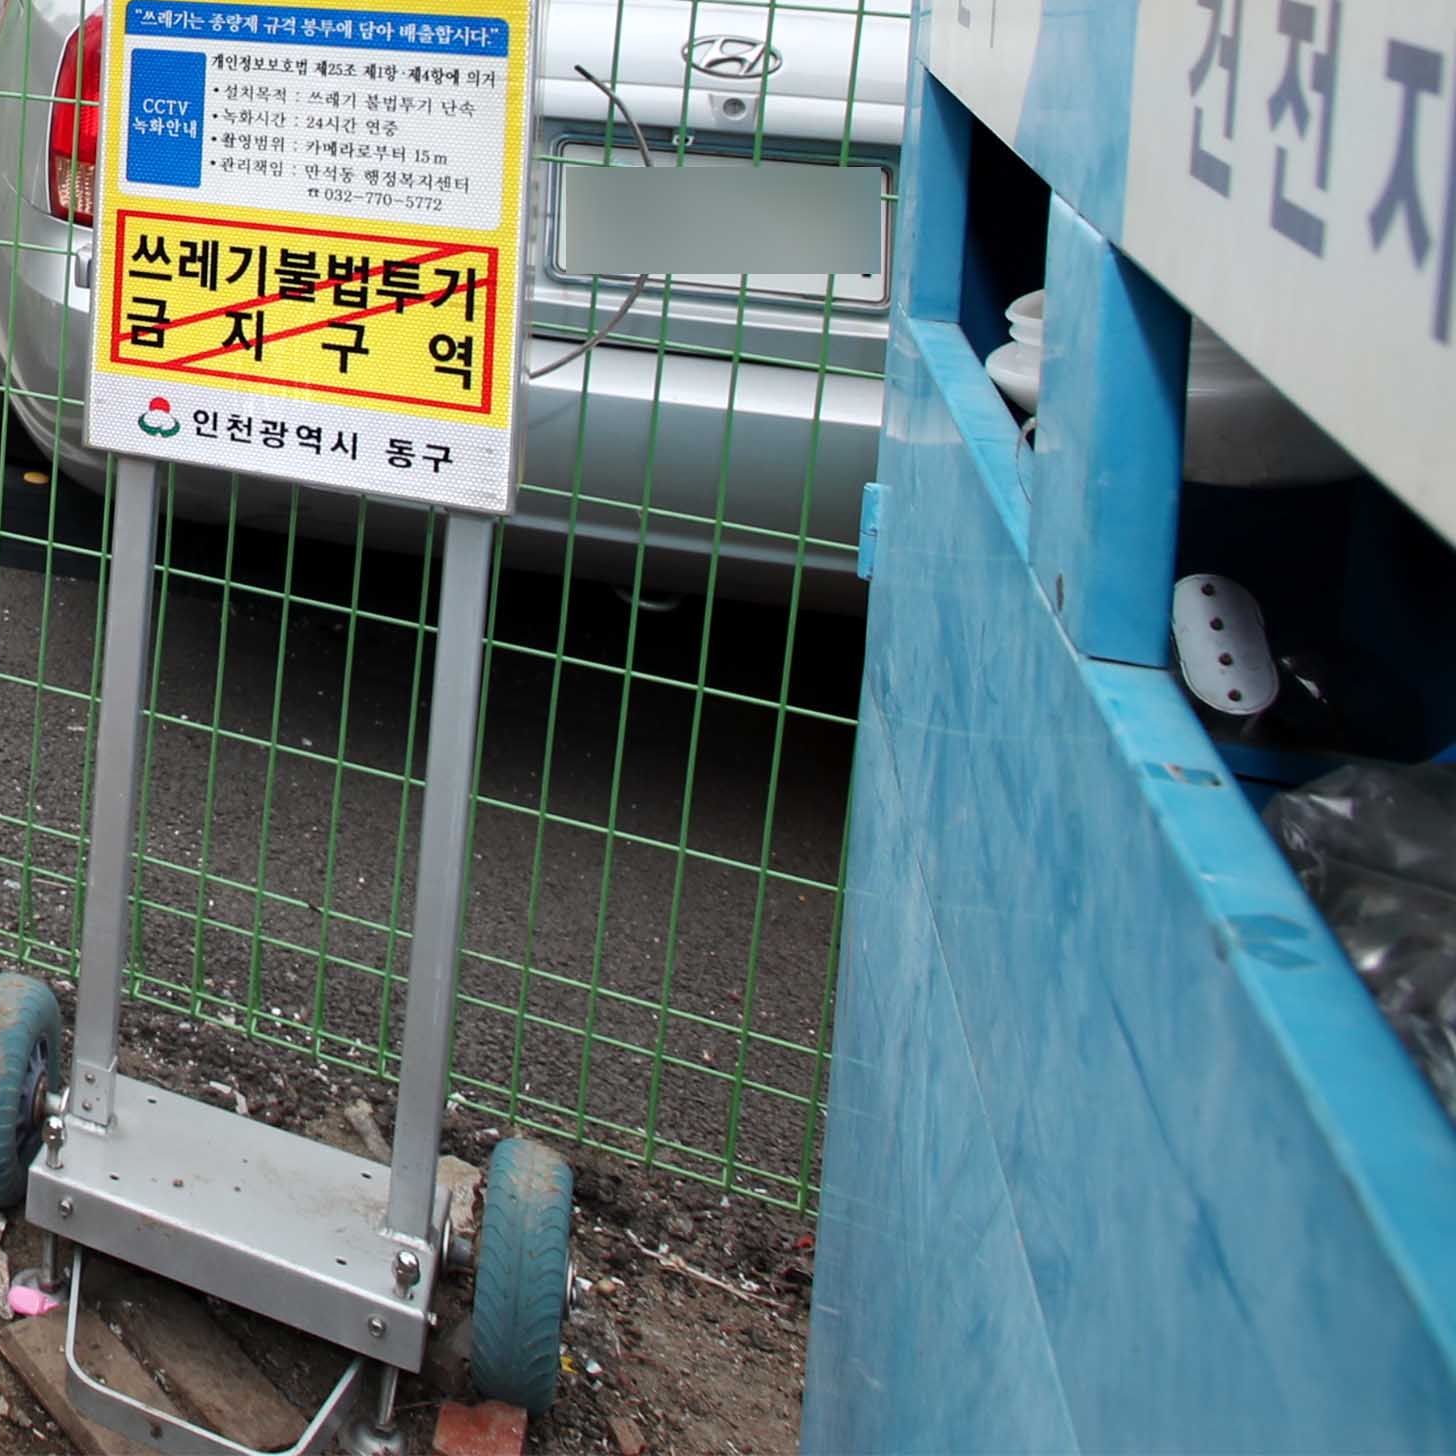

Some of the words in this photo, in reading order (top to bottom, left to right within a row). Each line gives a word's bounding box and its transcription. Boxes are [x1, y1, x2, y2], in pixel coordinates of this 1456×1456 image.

[208, 14, 259, 34] 종량제
[264, 14, 297, 36] 규격
[301, 17, 353, 39] 봉투에
[360, 21, 394, 41] 담아
[211, 54, 308, 75] 개인정보보호법
[315, 59, 357, 78] 제25조
[466, 69, 496, 88] 의거
[143, 98, 188, 114] CCTV
[224, 84, 287, 103] 설치목적
[307, 90, 356, 110] 쓰레기
[366, 94, 433, 113] 불법투기
[442, 99, 476, 118] 단속
[133, 117, 198, 139] 녹화안내
[223, 108, 286, 128] 녹화시간
[306, 115, 356, 134] 24시간
[366, 119, 399, 136] 연중
[221, 133, 286, 153] 촬영범위
[306, 140, 406, 164] 카메라로부터
[220, 157, 284, 178] 관리책임
[305, 164, 355, 185] 만석동
[365, 168, 470, 194] 행정복지센터
[324, 187, 442, 212] 032-770-5772
[128, 234, 477, 323] 쓰레기불법투기
[192, 408, 358, 461] 인천광역시
[386, 438, 454, 473] 동구
